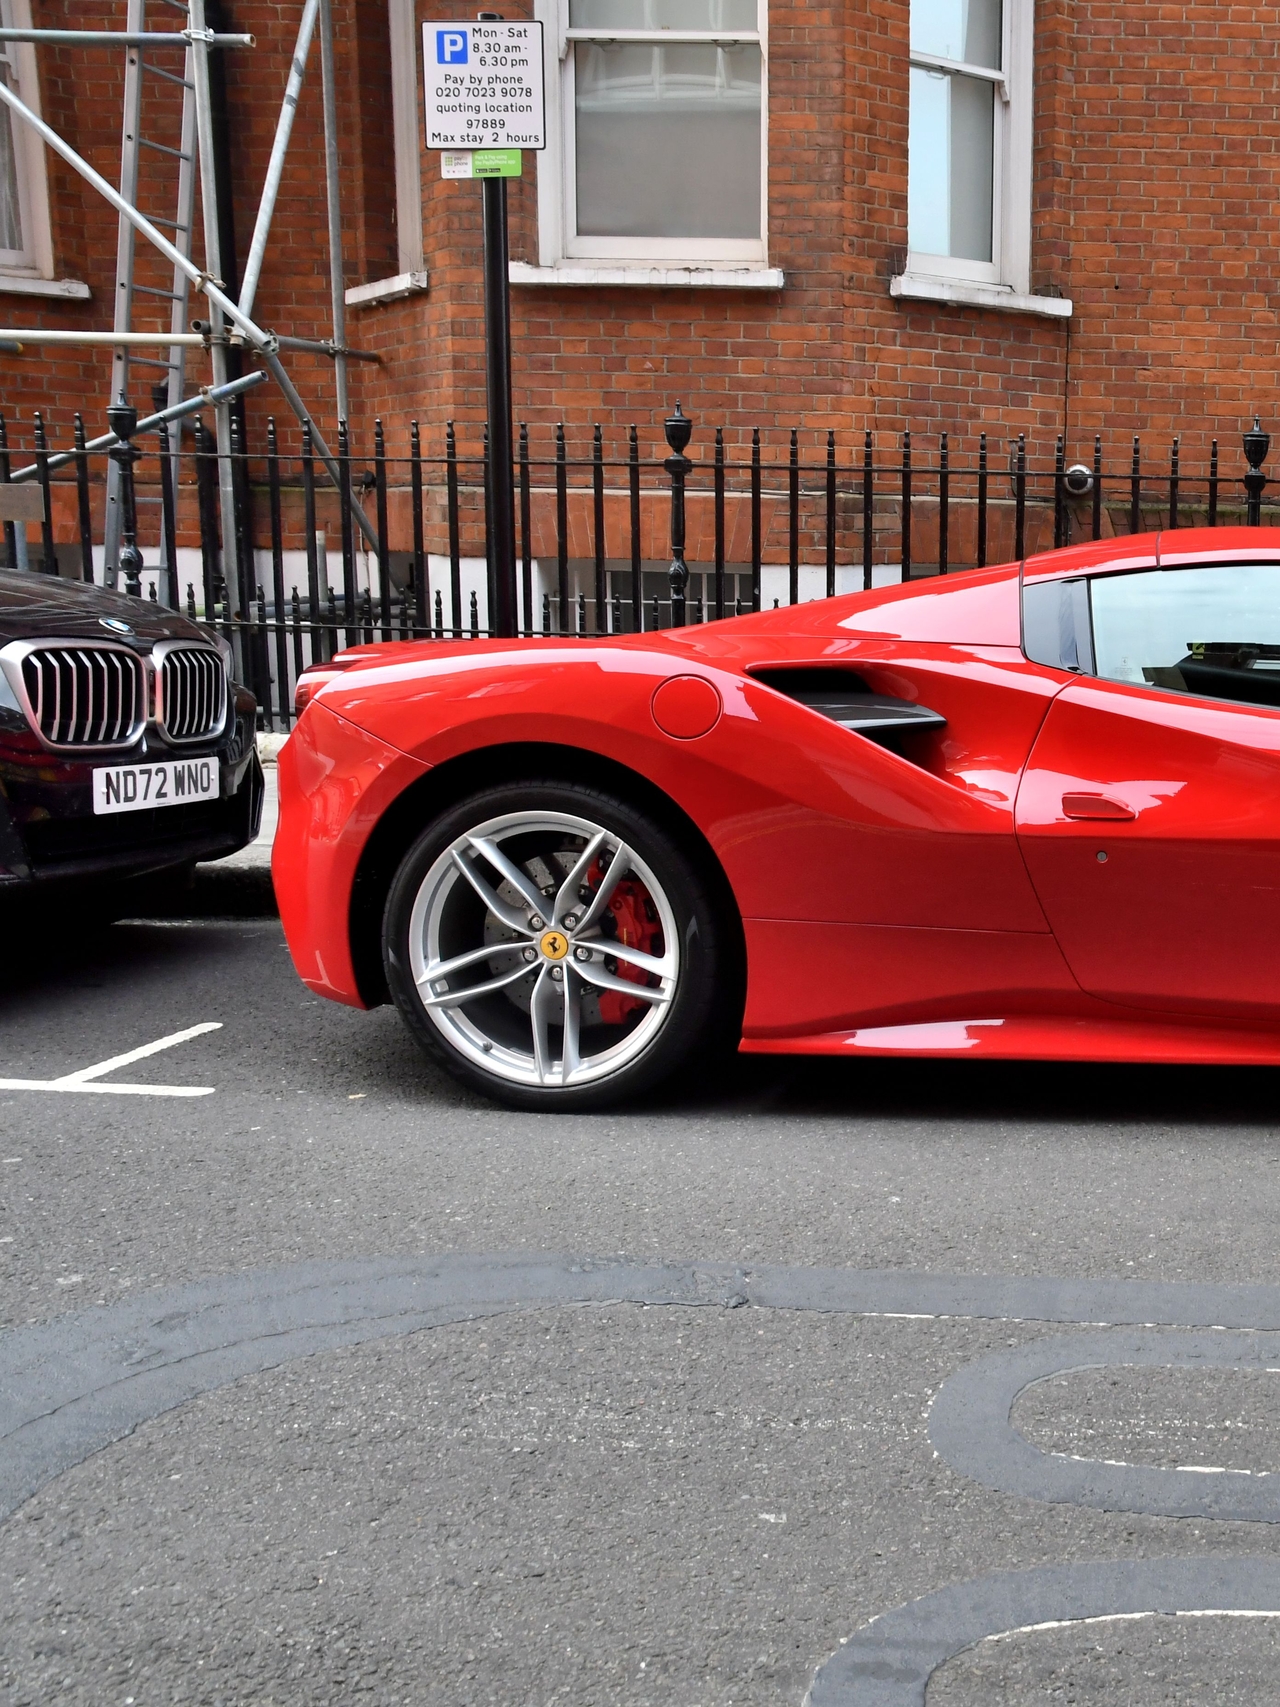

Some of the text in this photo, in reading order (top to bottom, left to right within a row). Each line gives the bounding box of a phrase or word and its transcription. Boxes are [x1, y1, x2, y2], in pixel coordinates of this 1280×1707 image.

[472, 28, 497, 38] Mon
[507, 28, 528, 38] Sat
[444, 34, 464, 61] P
[472, 42, 501, 53] 8.30
[504, 45, 521, 53] am
[480, 56, 528, 68] 6.30 pm
[444, 74, 523, 86] Pay by phone
[436, 87, 533, 98] 020 7023 9078
[436, 103, 533, 114] quoting location
[466, 119, 506, 129] 97889
[432, 132, 540, 144] Max stay 2 hours
[105, 762, 211, 805] ND72 WNO
